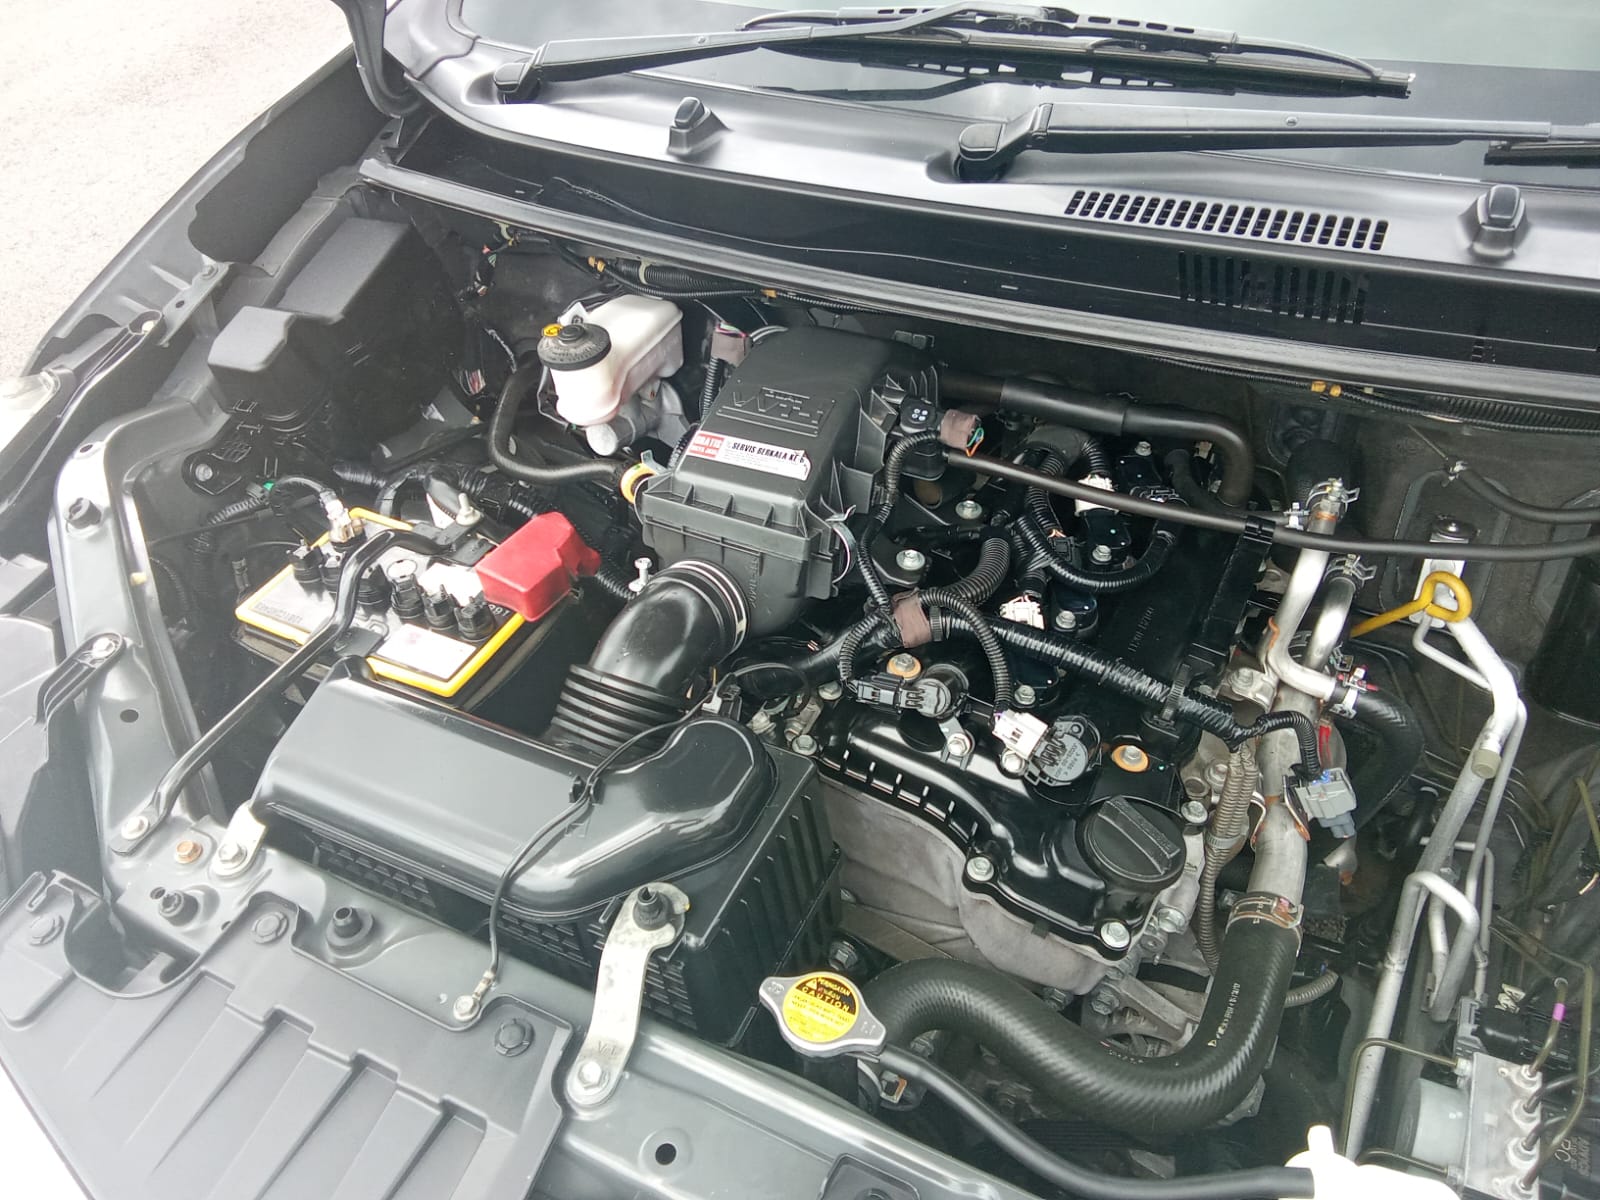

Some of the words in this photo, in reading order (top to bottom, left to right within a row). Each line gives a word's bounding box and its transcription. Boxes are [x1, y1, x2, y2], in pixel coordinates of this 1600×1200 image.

[731, 441, 757, 454] SERVIS
[756, 447, 788, 460] BERKALA
[788, 454, 799, 462] KE
[801, 986, 850, 1012] CAUTION
